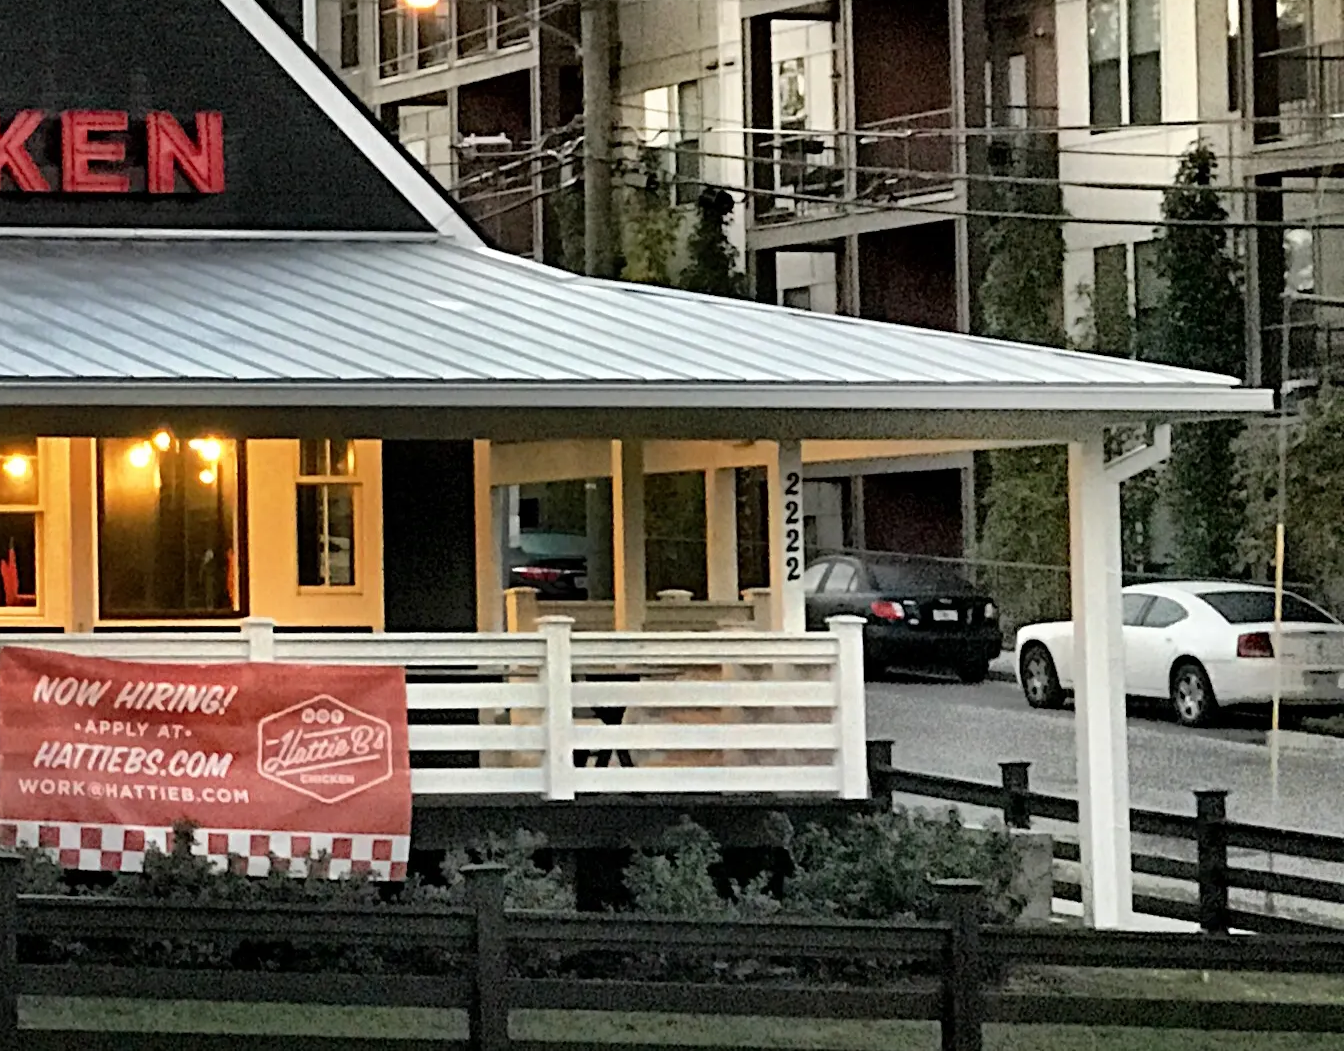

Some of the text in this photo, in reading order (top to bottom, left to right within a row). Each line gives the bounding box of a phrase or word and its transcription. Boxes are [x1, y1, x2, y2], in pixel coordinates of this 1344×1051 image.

[784, 472, 801, 582] 2222
[32, 675, 239, 715] NOW HIRING!
[84, 719, 185, 739] APPLY AT
[33, 740, 234, 779] HATTIEBS.COM
[263, 725, 385, 773] Hattie B's
[18, 778, 250, 804] WORK@HATTIEB.COM
